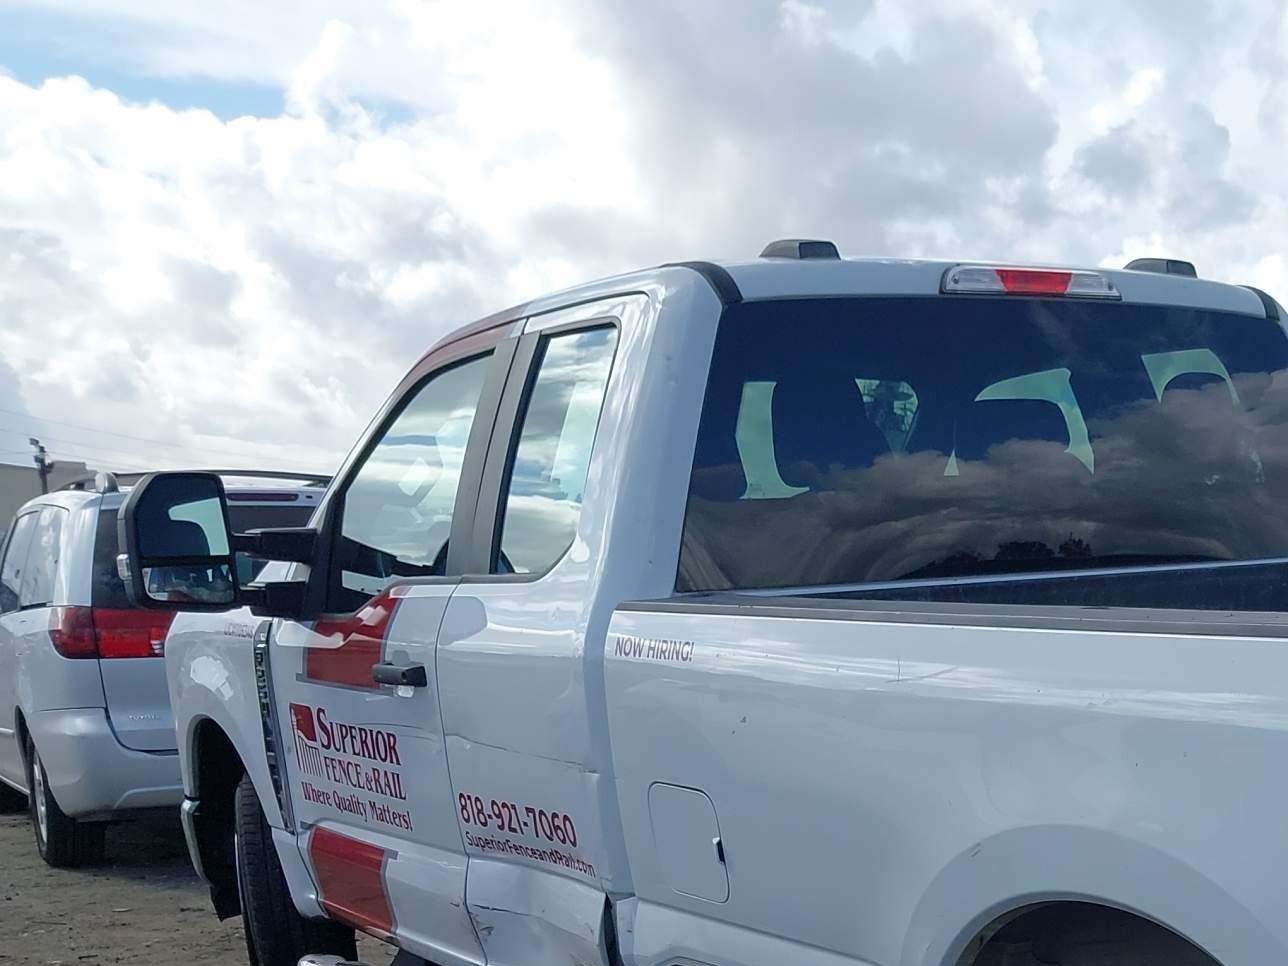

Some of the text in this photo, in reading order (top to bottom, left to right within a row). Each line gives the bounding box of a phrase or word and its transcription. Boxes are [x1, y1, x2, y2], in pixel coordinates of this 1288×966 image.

[614, 637, 695, 662] NOW HIRING!
[316, 707, 402, 766] SUPERIOR
[301, 781, 414, 833] Where Quality Matters!
[457, 792, 578, 848] 818-921-7060
[464, 831, 598, 879] SuperiorFenceandRail.com
